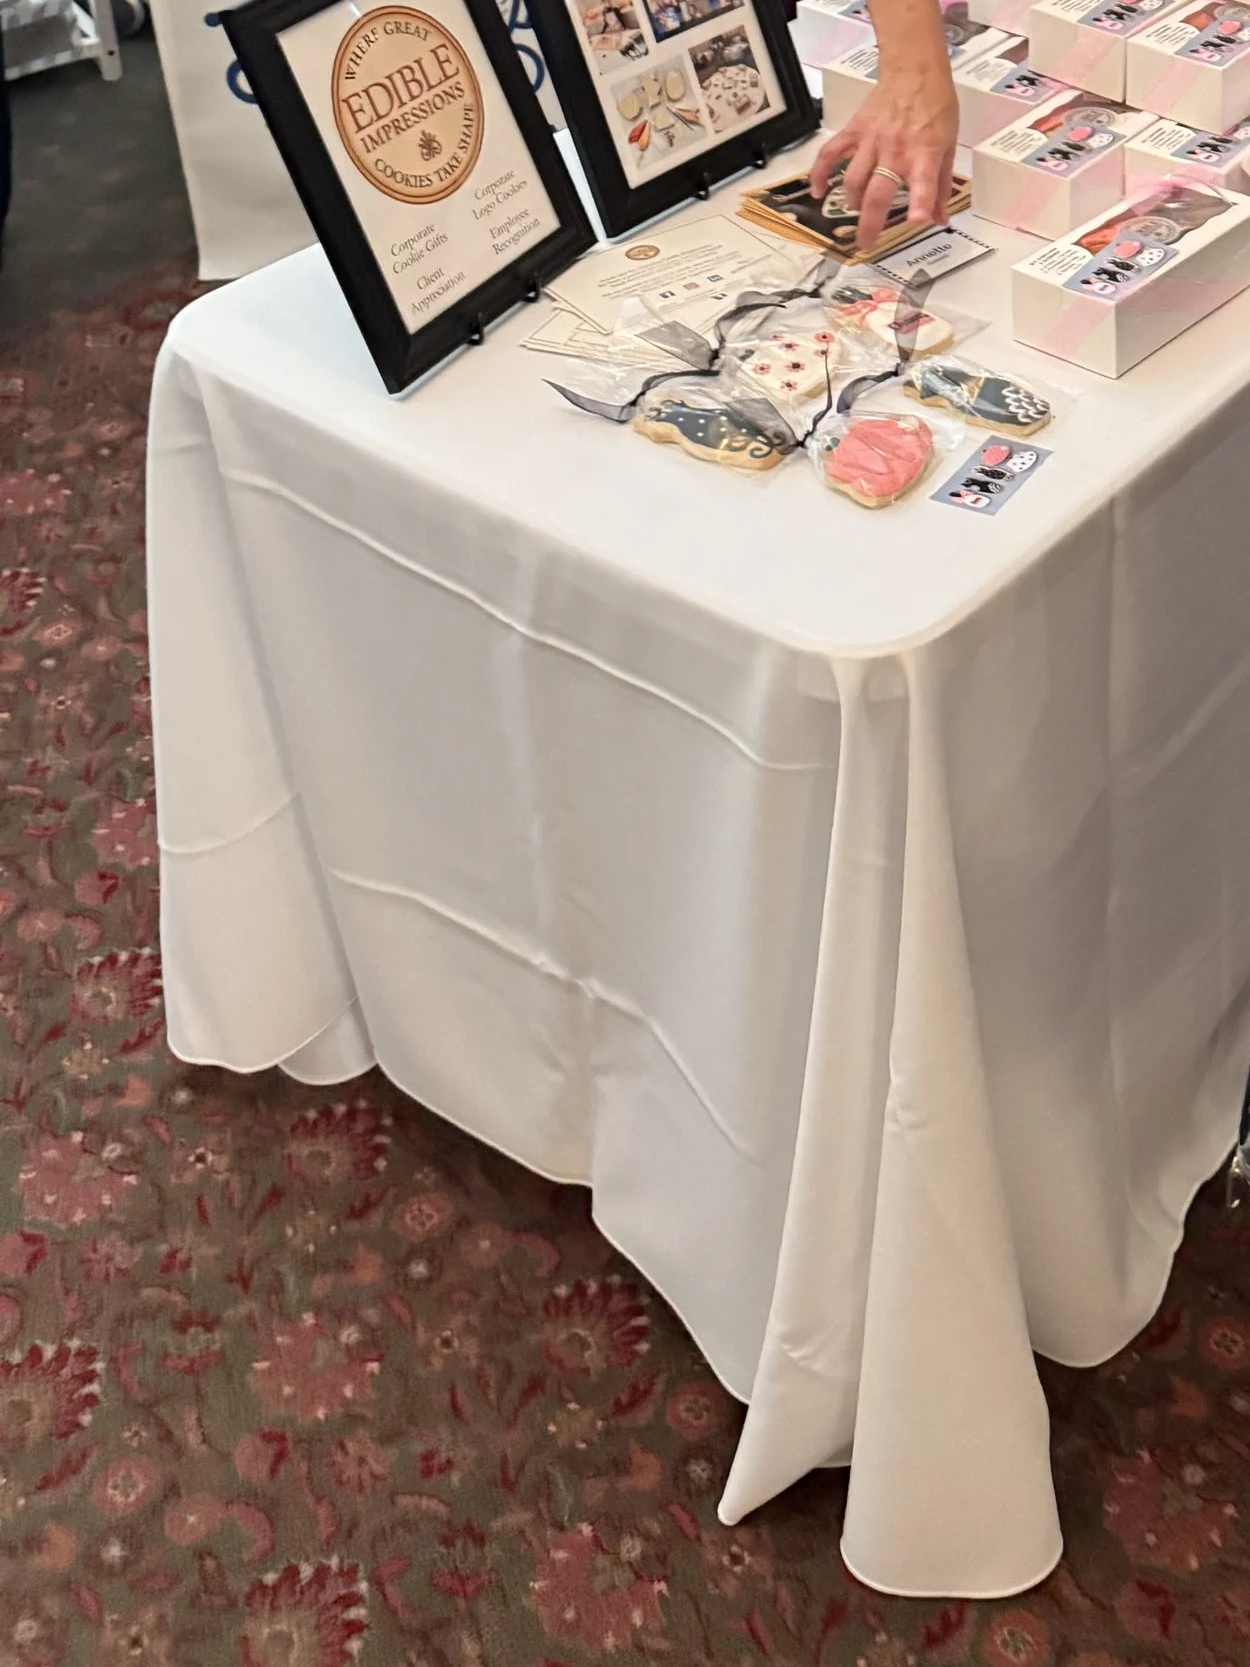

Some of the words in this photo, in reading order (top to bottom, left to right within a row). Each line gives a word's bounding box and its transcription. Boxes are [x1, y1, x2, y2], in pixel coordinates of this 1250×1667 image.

[345, 26, 378, 80] WHERE
[384, 21, 432, 42] GREAT
[342, 43, 460, 134] EDIBLE
[360, 81, 465, 154] IMPRESSIONS
[374, 158, 434, 188] COOKIES
[434, 152, 462, 182] TAKE
[459, 102, 475, 154] SHAPE
[472, 201, 496, 221] Logo
[495, 179, 528, 204] Cookies
[474, 169, 515, 201] Corporate
[390, 224, 436, 257] Corporate
[489, 207, 530, 239] Employee
[492, 217, 541, 255] Recognition
[392, 248, 425, 275] Cookie
[425, 233, 449, 252] Gifts
[410, 271, 466, 315] Appreciation
[416, 267, 445, 290] Client
